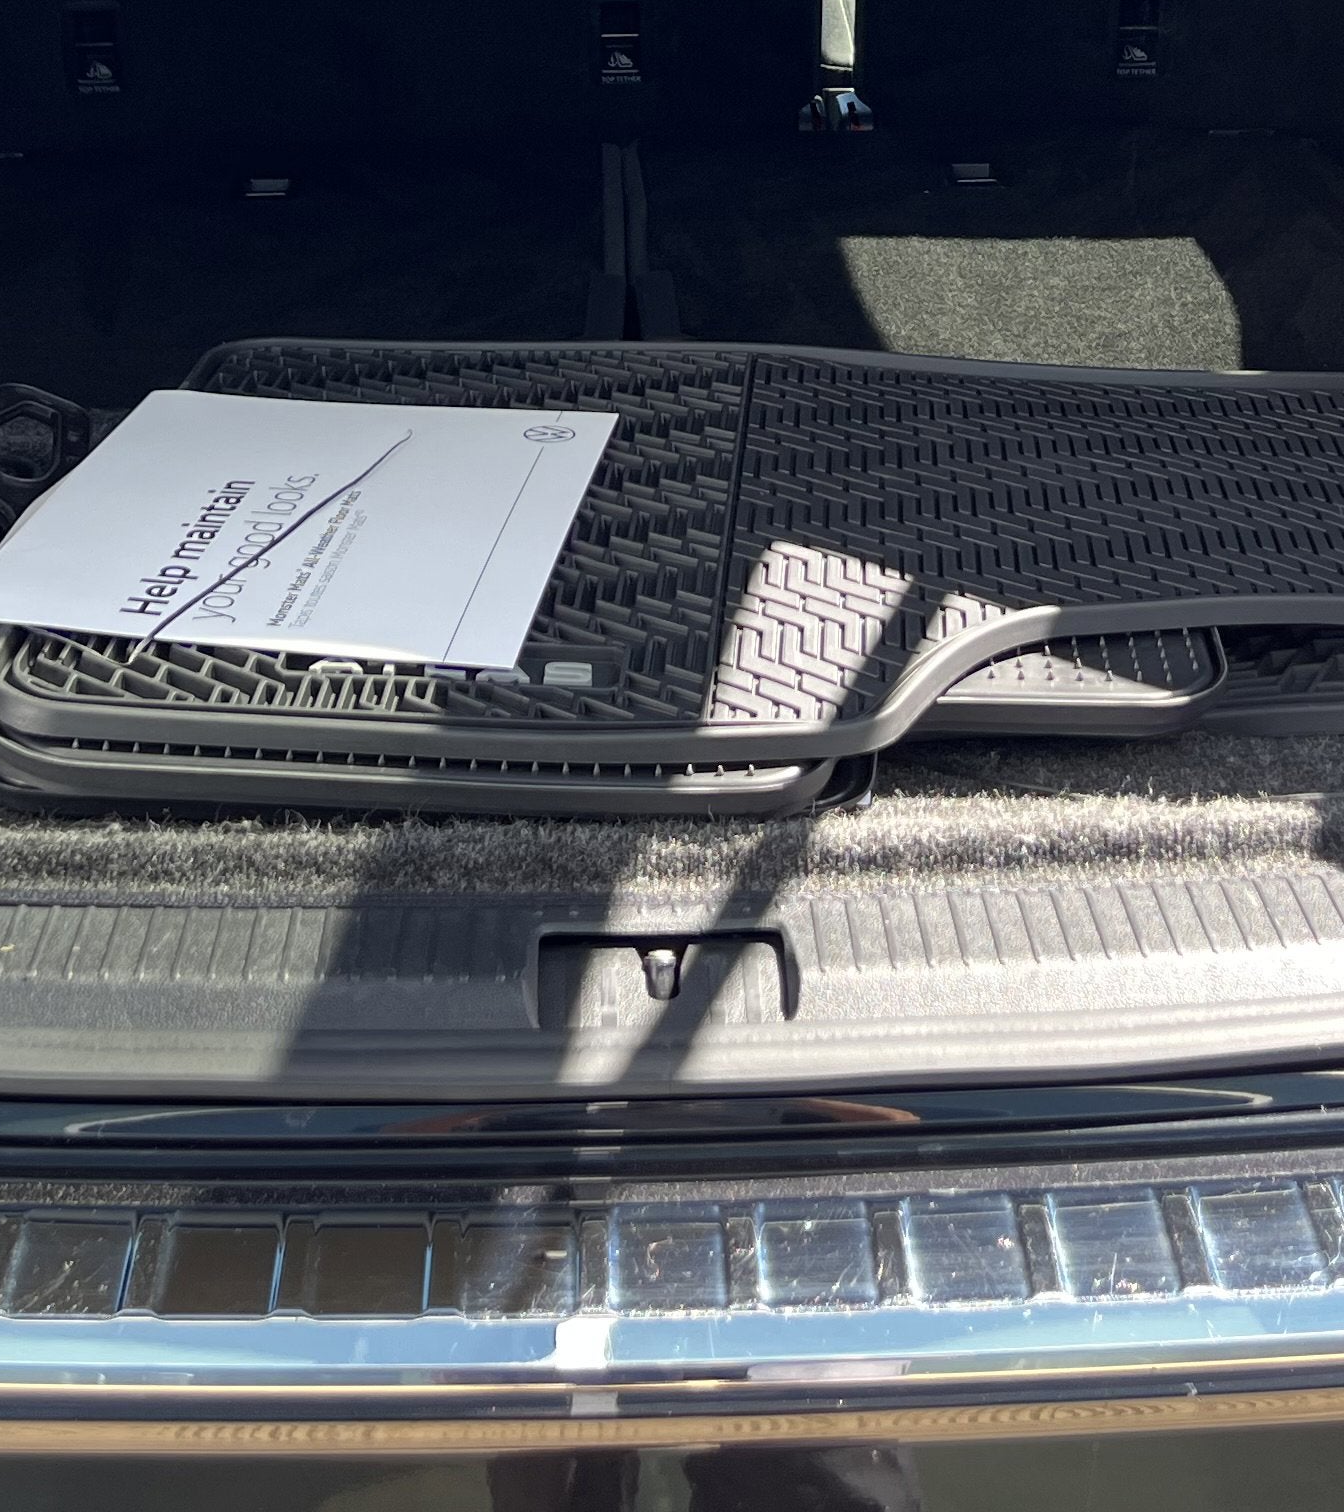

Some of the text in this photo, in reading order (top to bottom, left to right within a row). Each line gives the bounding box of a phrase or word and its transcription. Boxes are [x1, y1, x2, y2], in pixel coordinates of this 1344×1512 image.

[119, 478, 256, 616] Help maintain
[192, 473, 320, 623] your good looks.
[266, 592, 298, 626] Monster
[301, 524, 339, 569] All-Weather
[340, 490, 362, 507] Mats
